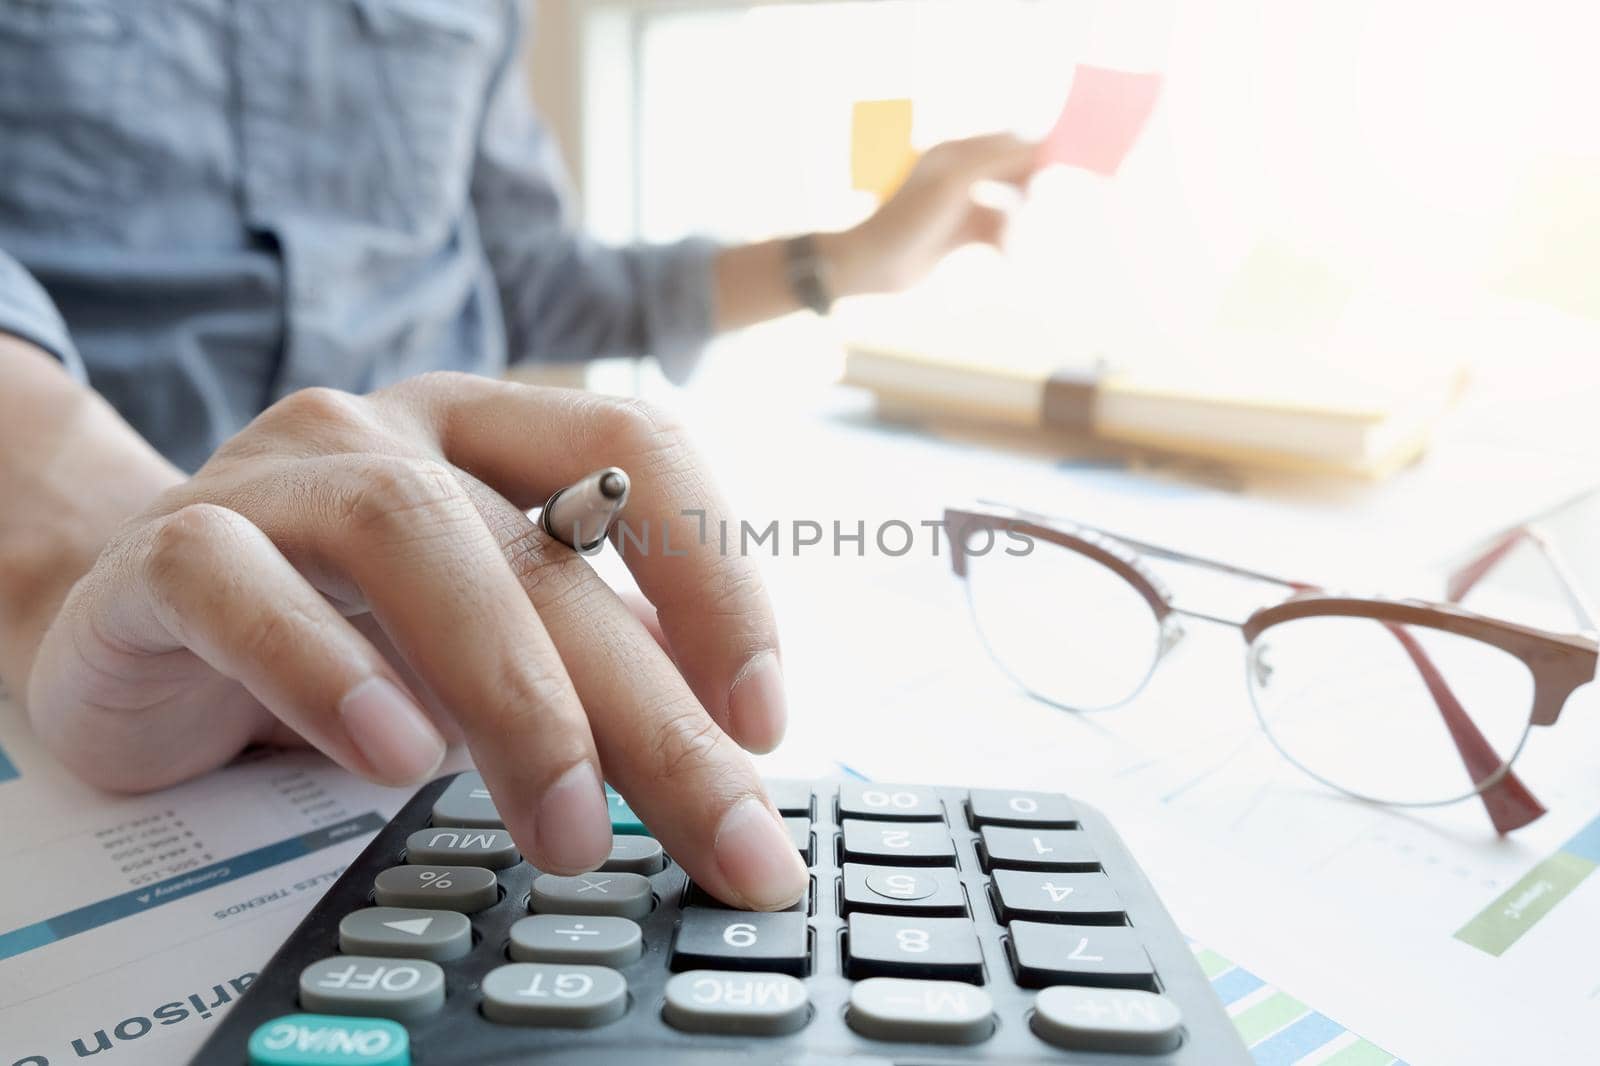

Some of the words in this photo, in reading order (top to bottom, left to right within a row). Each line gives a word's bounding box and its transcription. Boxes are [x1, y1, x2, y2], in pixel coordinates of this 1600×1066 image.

[863, 790, 919, 809] 00
[428, 832, 497, 850] MU
[880, 830, 911, 848] 2
[1032, 836, 1053, 854] 1
[885, 874, 918, 896] 5
[1042, 881, 1074, 902] 4
[213, 888, 290, 920] TRENDS
[723, 923, 758, 948] 9
[895, 928, 931, 953] 8
[1066, 936, 1104, 962] 7
[318, 964, 422, 992] OFF
[516, 971, 595, 998] GT
[692, 977, 792, 1008] MRC
